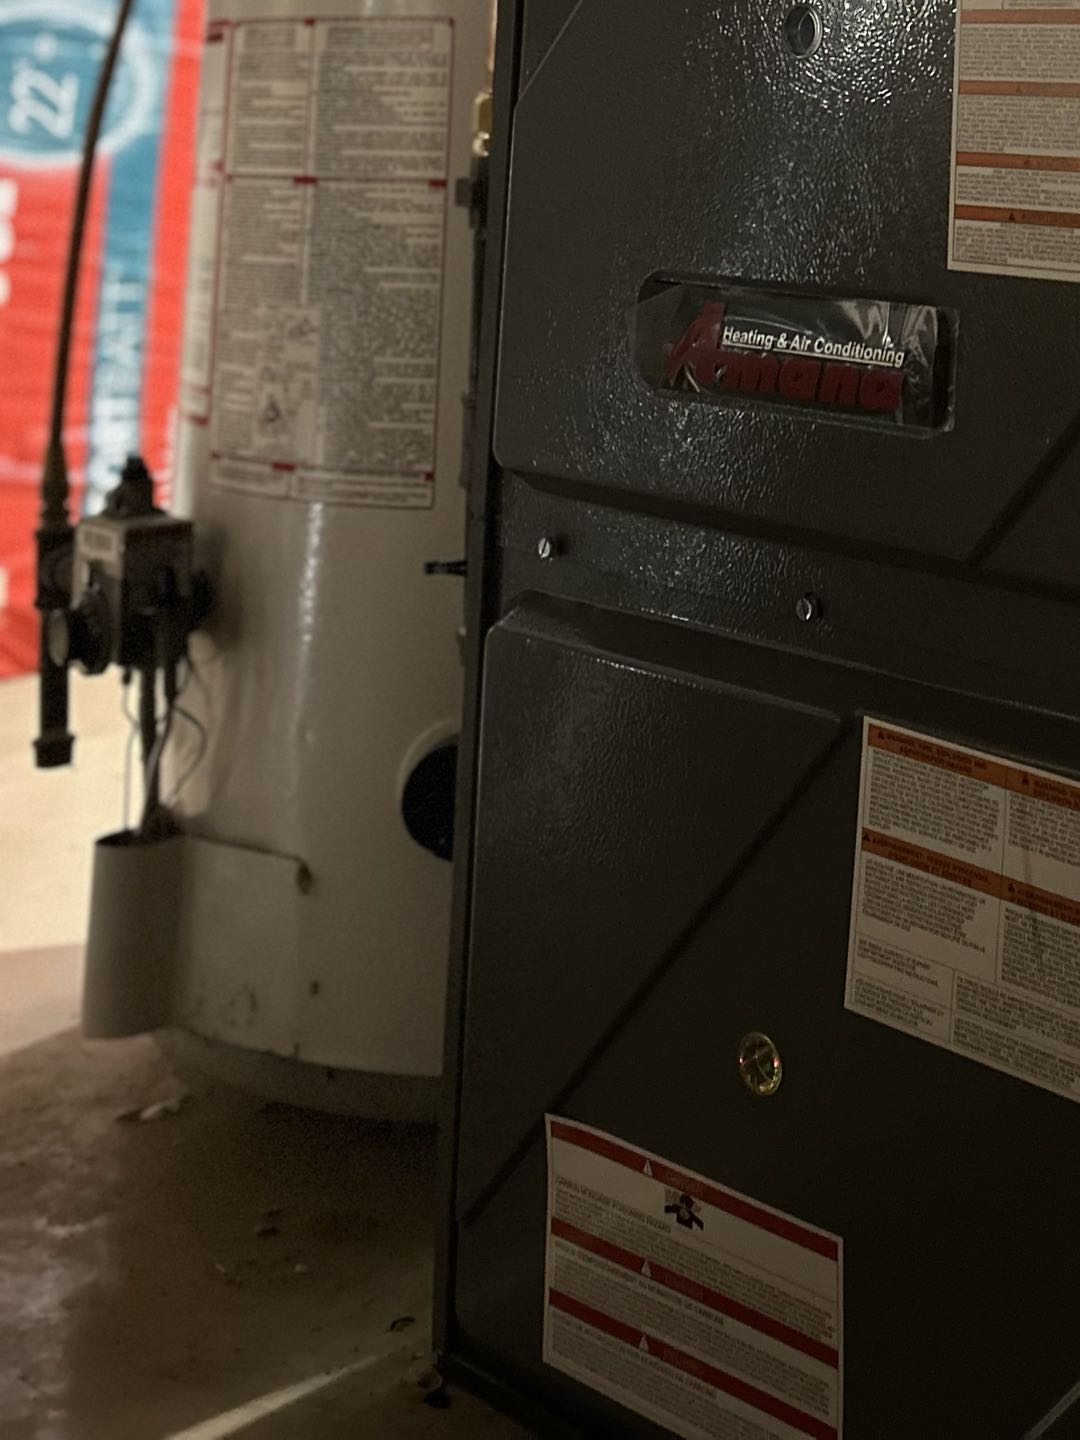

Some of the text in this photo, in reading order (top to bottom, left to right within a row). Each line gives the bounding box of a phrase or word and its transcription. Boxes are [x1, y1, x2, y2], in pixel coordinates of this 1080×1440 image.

[662, 299, 904, 410] Amana
[721, 325, 905, 368] Heating & Air Conditioning
